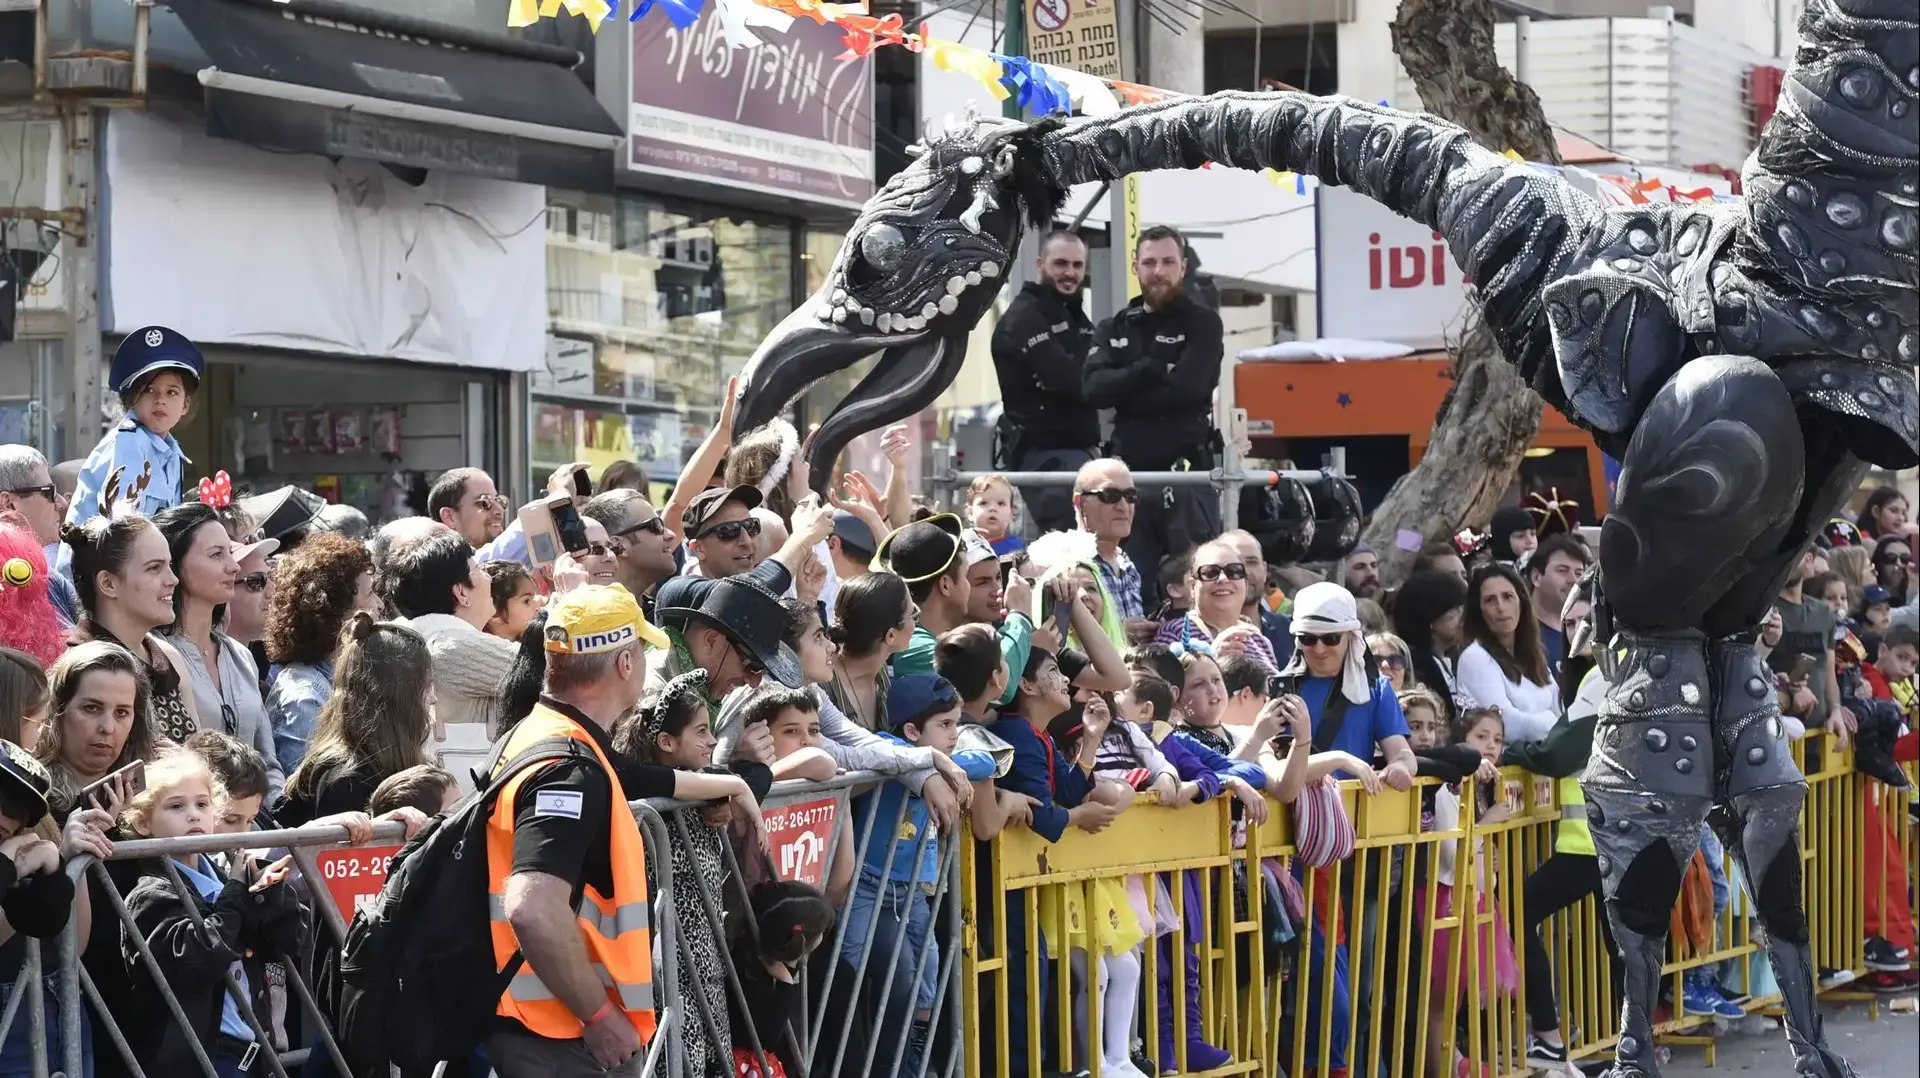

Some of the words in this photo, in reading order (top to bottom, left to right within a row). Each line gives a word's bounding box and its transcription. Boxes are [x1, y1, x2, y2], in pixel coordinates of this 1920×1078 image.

[1033, 30, 1074, 50] גבוה!
[1081, 24, 1114, 42] מתח
[1078, 41, 1115, 61] סכנת
[1085, 59, 1118, 77] Death!
[1369, 232, 1473, 290] וטו
[576, 626, 633, 652] בטחון
[765, 804, 835, 833] 052-2647777
[324, 855, 392, 879] 052-26
